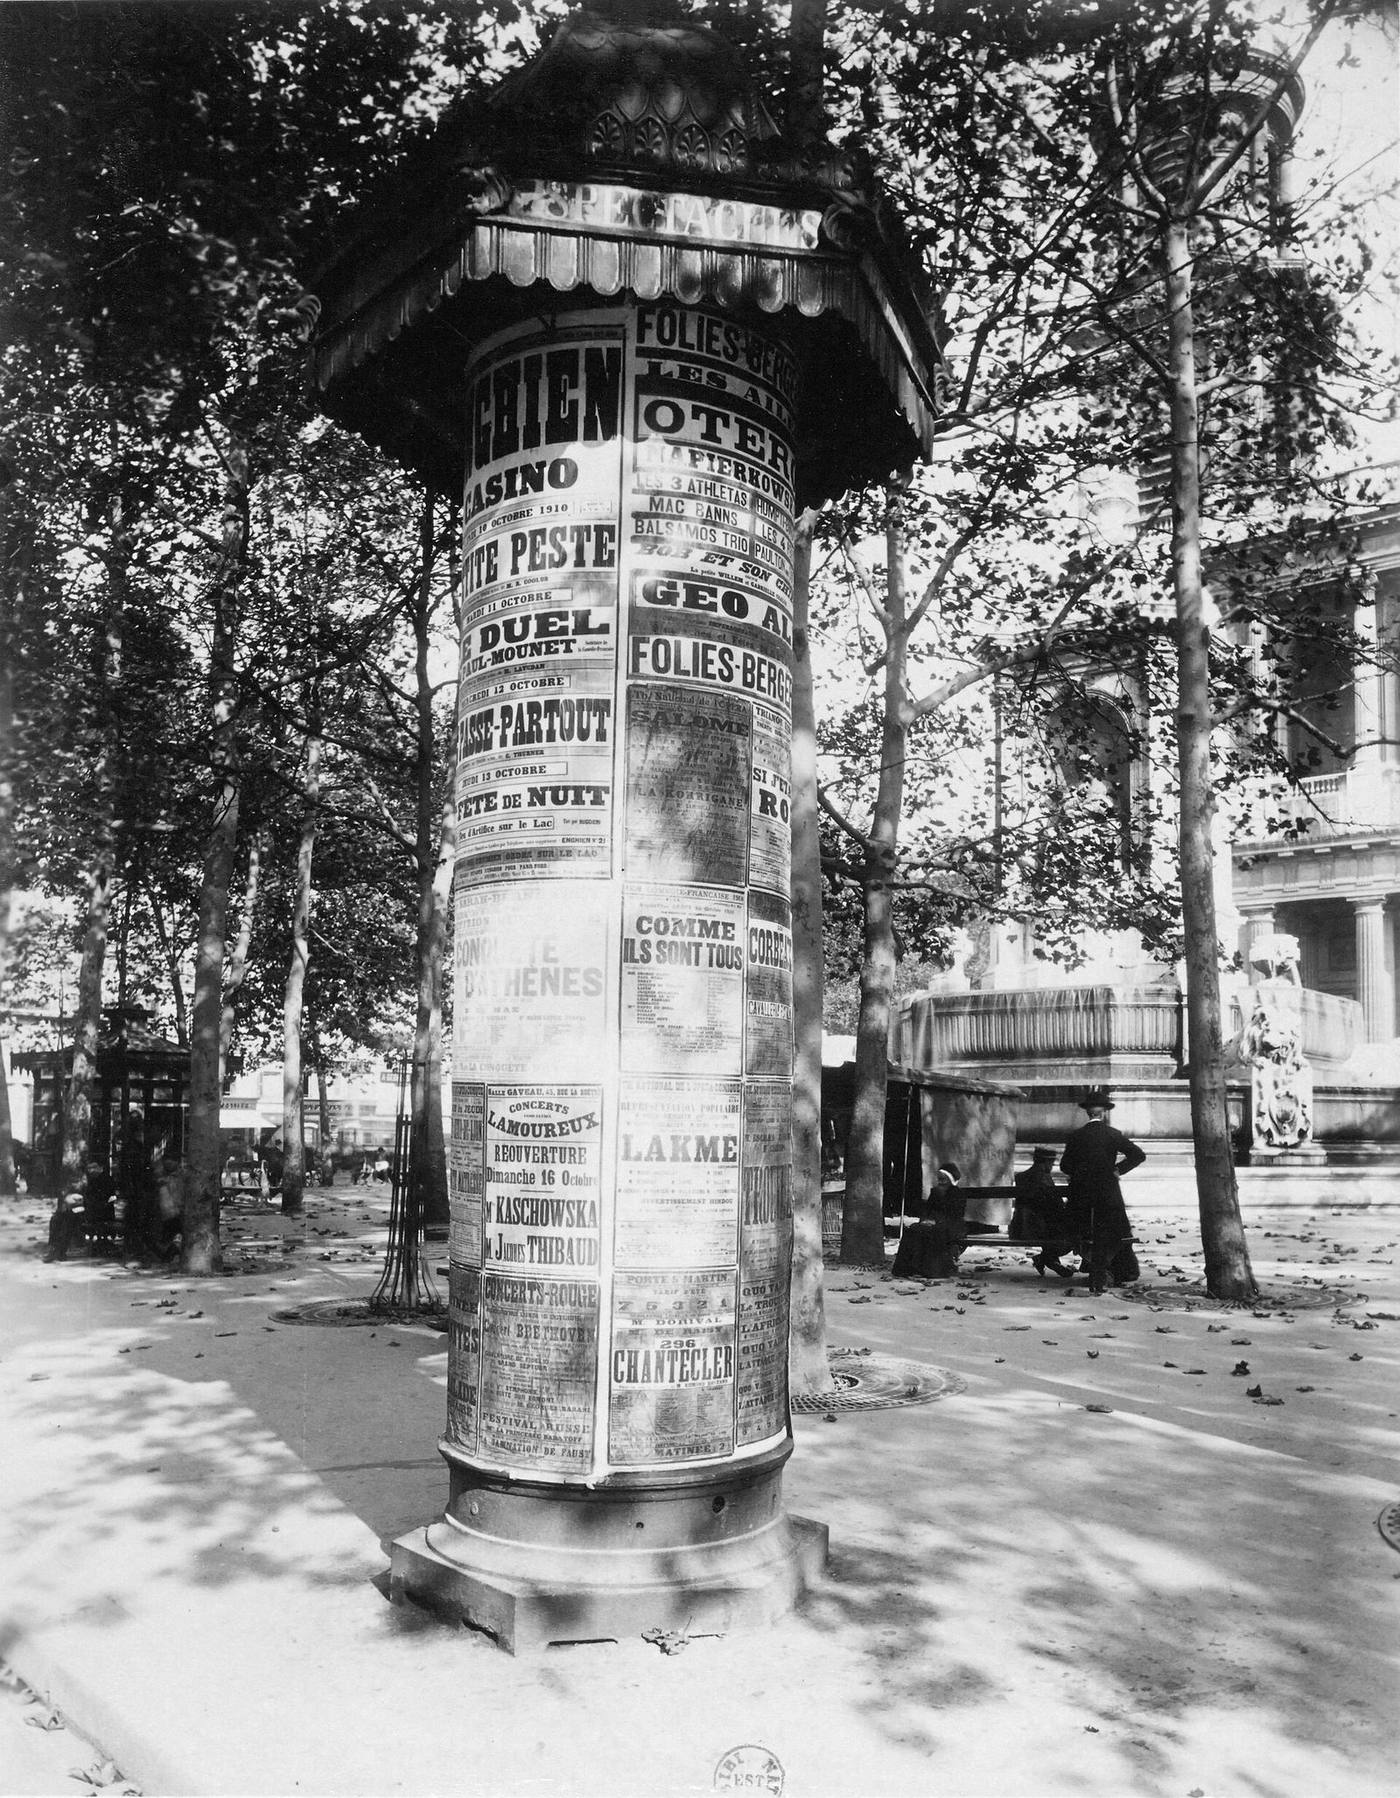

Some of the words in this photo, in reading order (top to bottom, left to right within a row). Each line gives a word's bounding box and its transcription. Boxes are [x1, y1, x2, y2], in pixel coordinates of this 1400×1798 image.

[648, 361, 728, 390] LES
[671, 476, 682, 490] 3
[688, 479, 748, 507] ATHLETAS
[491, 508, 533, 528] OCTOBRE
[540, 504, 569, 515] 1910
[650, 496, 685, 514] MAC
[696, 504, 738, 526] BANNS
[635, 519, 717, 543] BALSAMOS
[722, 531, 748, 553] TRIO
[762, 523, 777, 544] LES
[511, 524, 616, 576] PESTE
[700, 551, 735, 567] ET
[739, 562, 773, 583] SON
[501, 591, 552, 608] OCTOBRE
[642, 579, 749, 620] GEO
[480, 608, 610, 653] DUEL
[461, 638, 577, 682] PAUL-MOUNET
[494, 684, 505, 695] 12
[509, 676, 565, 691] OCTOBRE
[457, 697, 611, 763] PASSE-PARTOUT
[482, 772, 491, 781] 13
[495, 765, 547, 779] OCTOBRE
[752, 767, 767, 784] SI
[502, 793, 522, 810] DE
[527, 785, 610, 807] NUIT
[498, 822, 514, 832] sur
[519, 820, 528, 829] le
[533, 819, 553, 828] Lac
[636, 914, 736, 942] COMME
[623, 937, 653, 965] ILS
[655, 939, 703, 967] SONT
[706, 942, 743, 971] TOUS
[509, 1100, 570, 1115] CONCERTS
[487, 1111, 600, 1139] LAMOUREUX
[494, 1144, 587, 1165] REOUVERTURE
[486, 1166, 536, 1186] Dimanche
[541, 1169, 555, 1186] 16
[496, 1195, 599, 1229] KASCHOWSKA
[527, 1234, 599, 1267] THIBAUD
[656, 1317, 722, 1326] DORIVAL
[660, 1339, 696, 1349] 296
[613, 1345, 733, 1384] CHANTECLER
[482, 1412, 537, 1430] FESTIVAL
[544, 1447, 556, 1456] DE
[561, 1447, 591, 1459] FAUST
